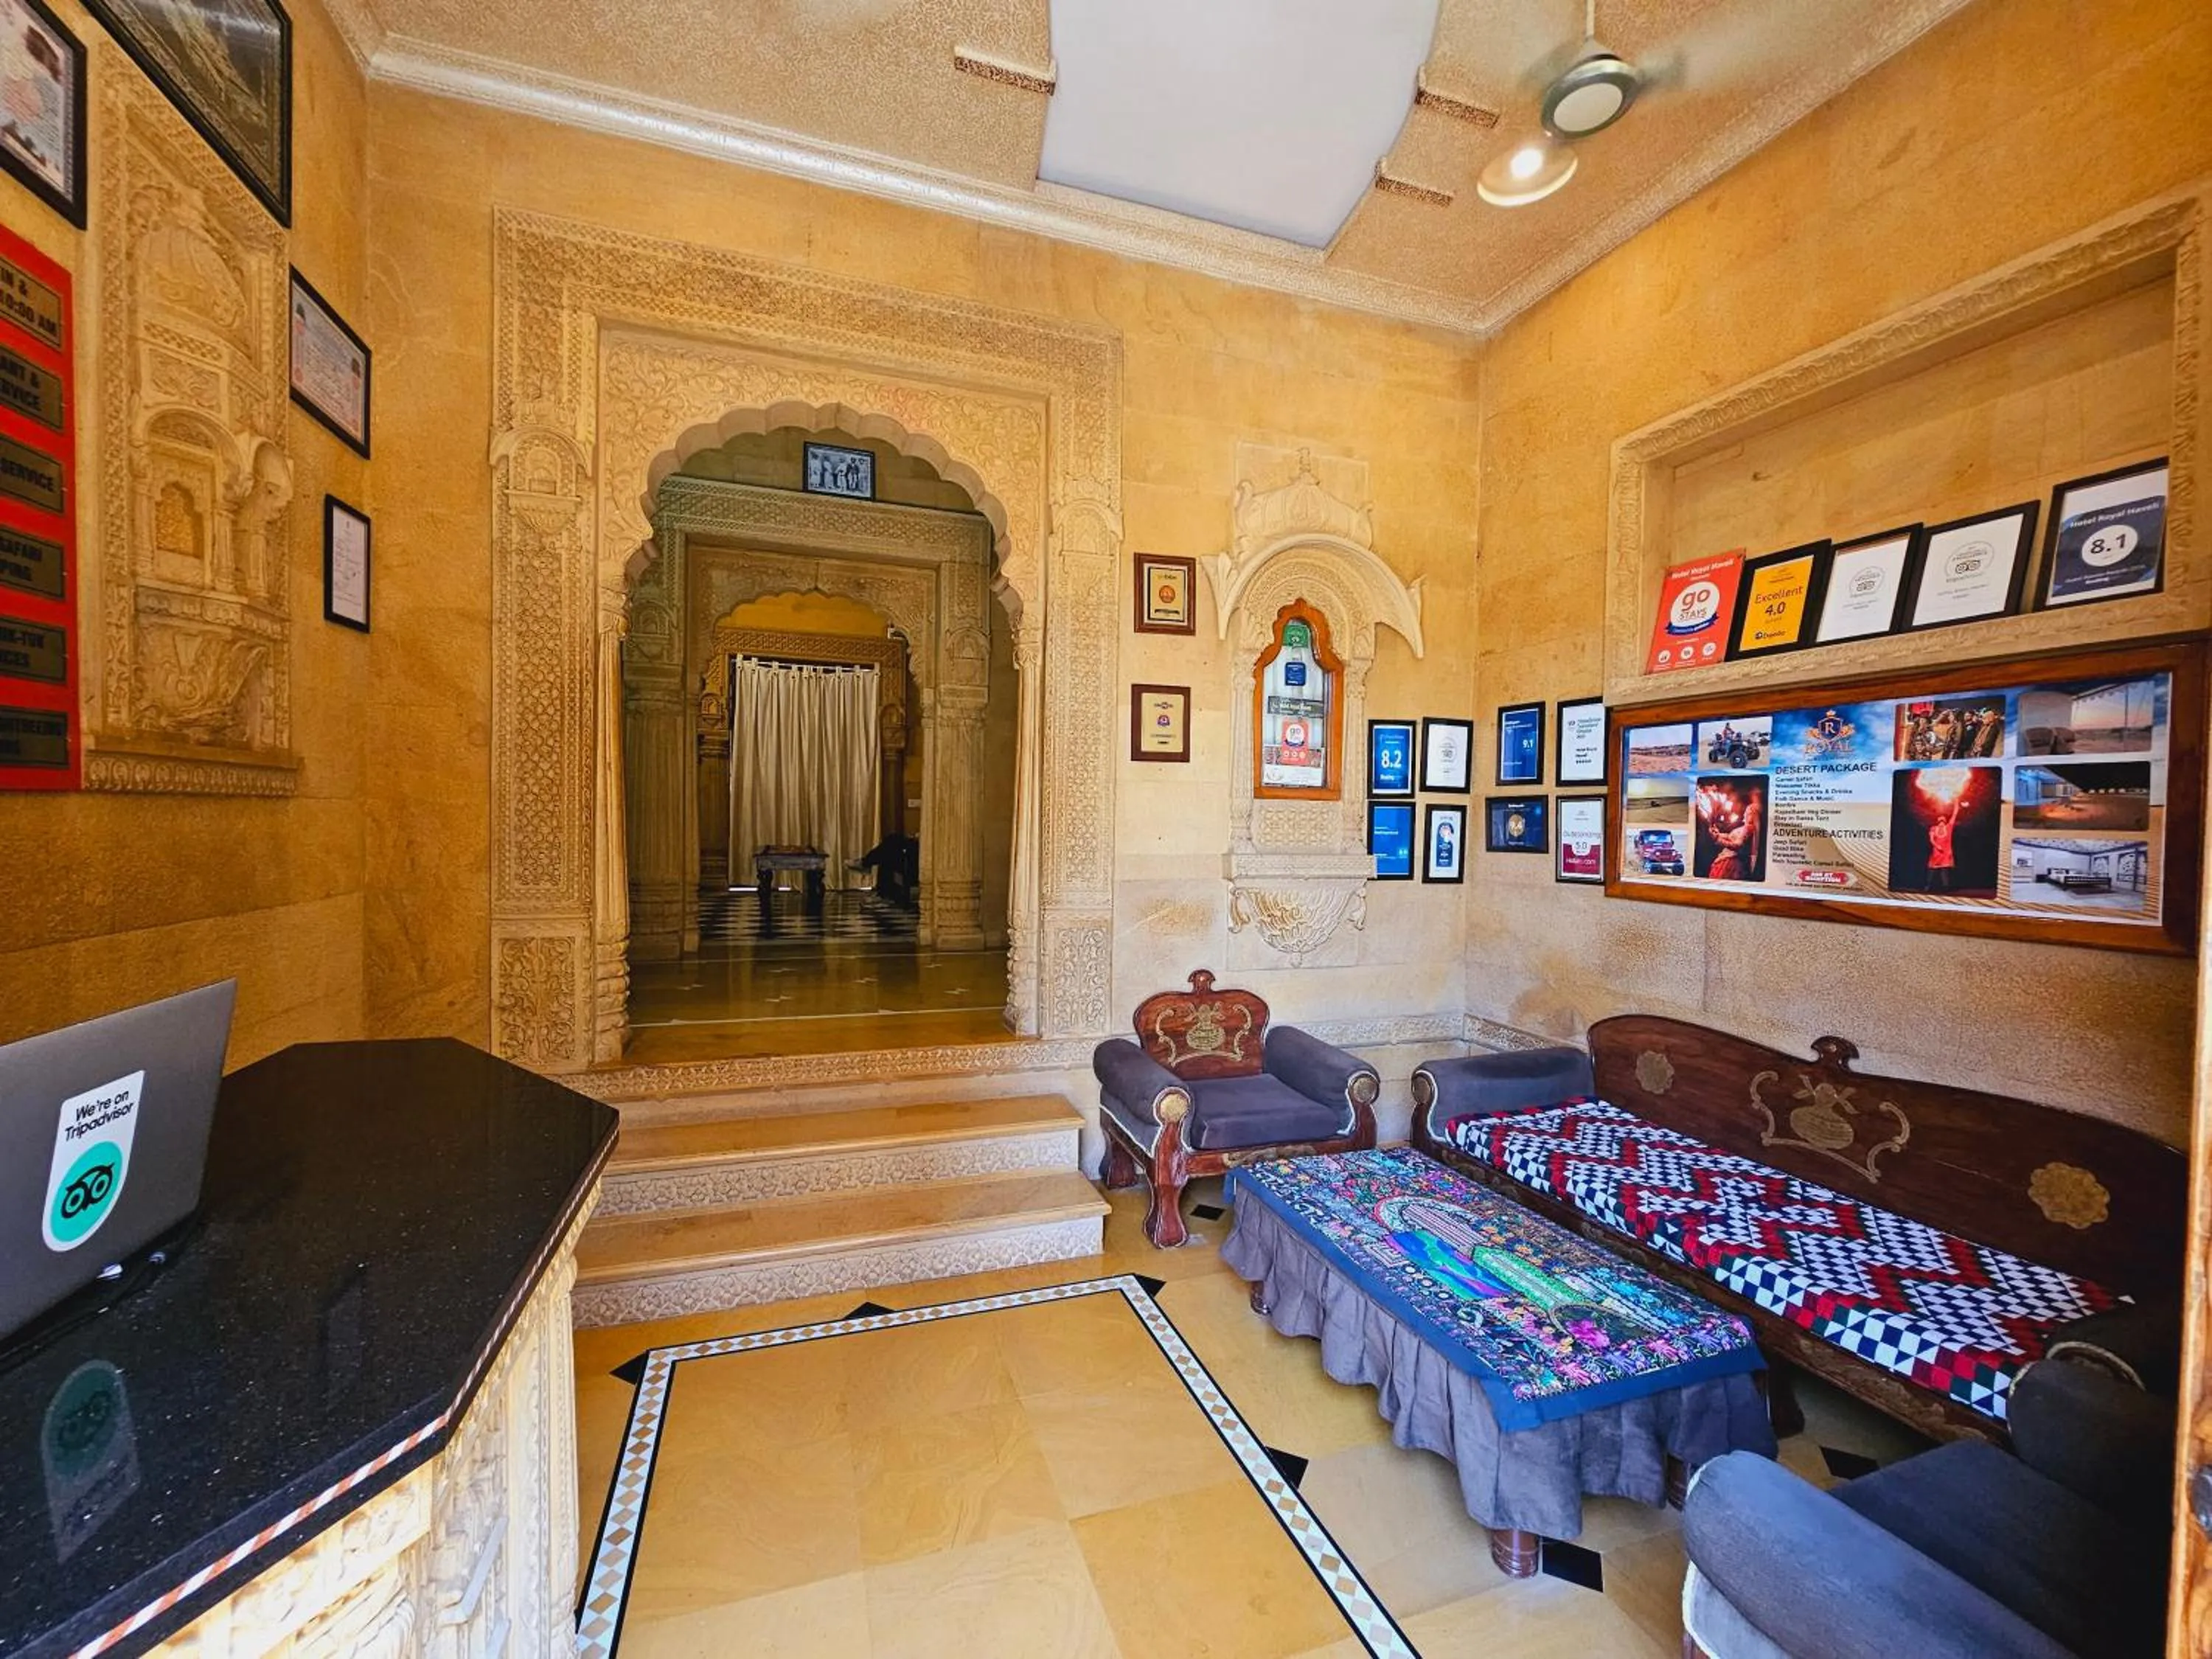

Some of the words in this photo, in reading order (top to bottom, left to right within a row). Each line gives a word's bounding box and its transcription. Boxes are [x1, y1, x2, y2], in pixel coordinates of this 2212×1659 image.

[18, 279, 28, 296] &
[38, 314, 58, 337] AM
[30, 372, 40, 389] &
[0, 456, 55, 493] SERVICE
[2069, 518, 2096, 529] Hotel
[2098, 510, 2126, 522] Royal
[2127, 501, 2160, 515] Haveli
[2090, 533, 2126, 554] 8.1
[1671, 569, 1690, 580] Hotel
[1690, 563, 1711, 575] Royal
[1711, 557, 1735, 569] Haveli
[1681, 588, 1711, 612] go
[1754, 585, 1804, 605] Excellent
[1679, 607, 1708, 622] STAYS
[1764, 600, 1787, 617] 4.0
[1824, 722, 1836, 734] R
[1522, 740, 1534, 749] 9.1
[1804, 740, 1854, 755] ROYAL
[1380, 748, 1402, 769] 8.2
[1775, 765, 1818, 775] DESERT
[1820, 762, 1877, 773] PACKAGE
[1773, 828, 1827, 838] ADVENTURE
[1829, 829, 1884, 840] ACTIVITIES
[1575, 841, 1587, 849] 5.0
[75, 1098, 111, 1121] We're
[114, 1091, 129, 1105] on
[65, 1103, 133, 1141] Tripadvisor
